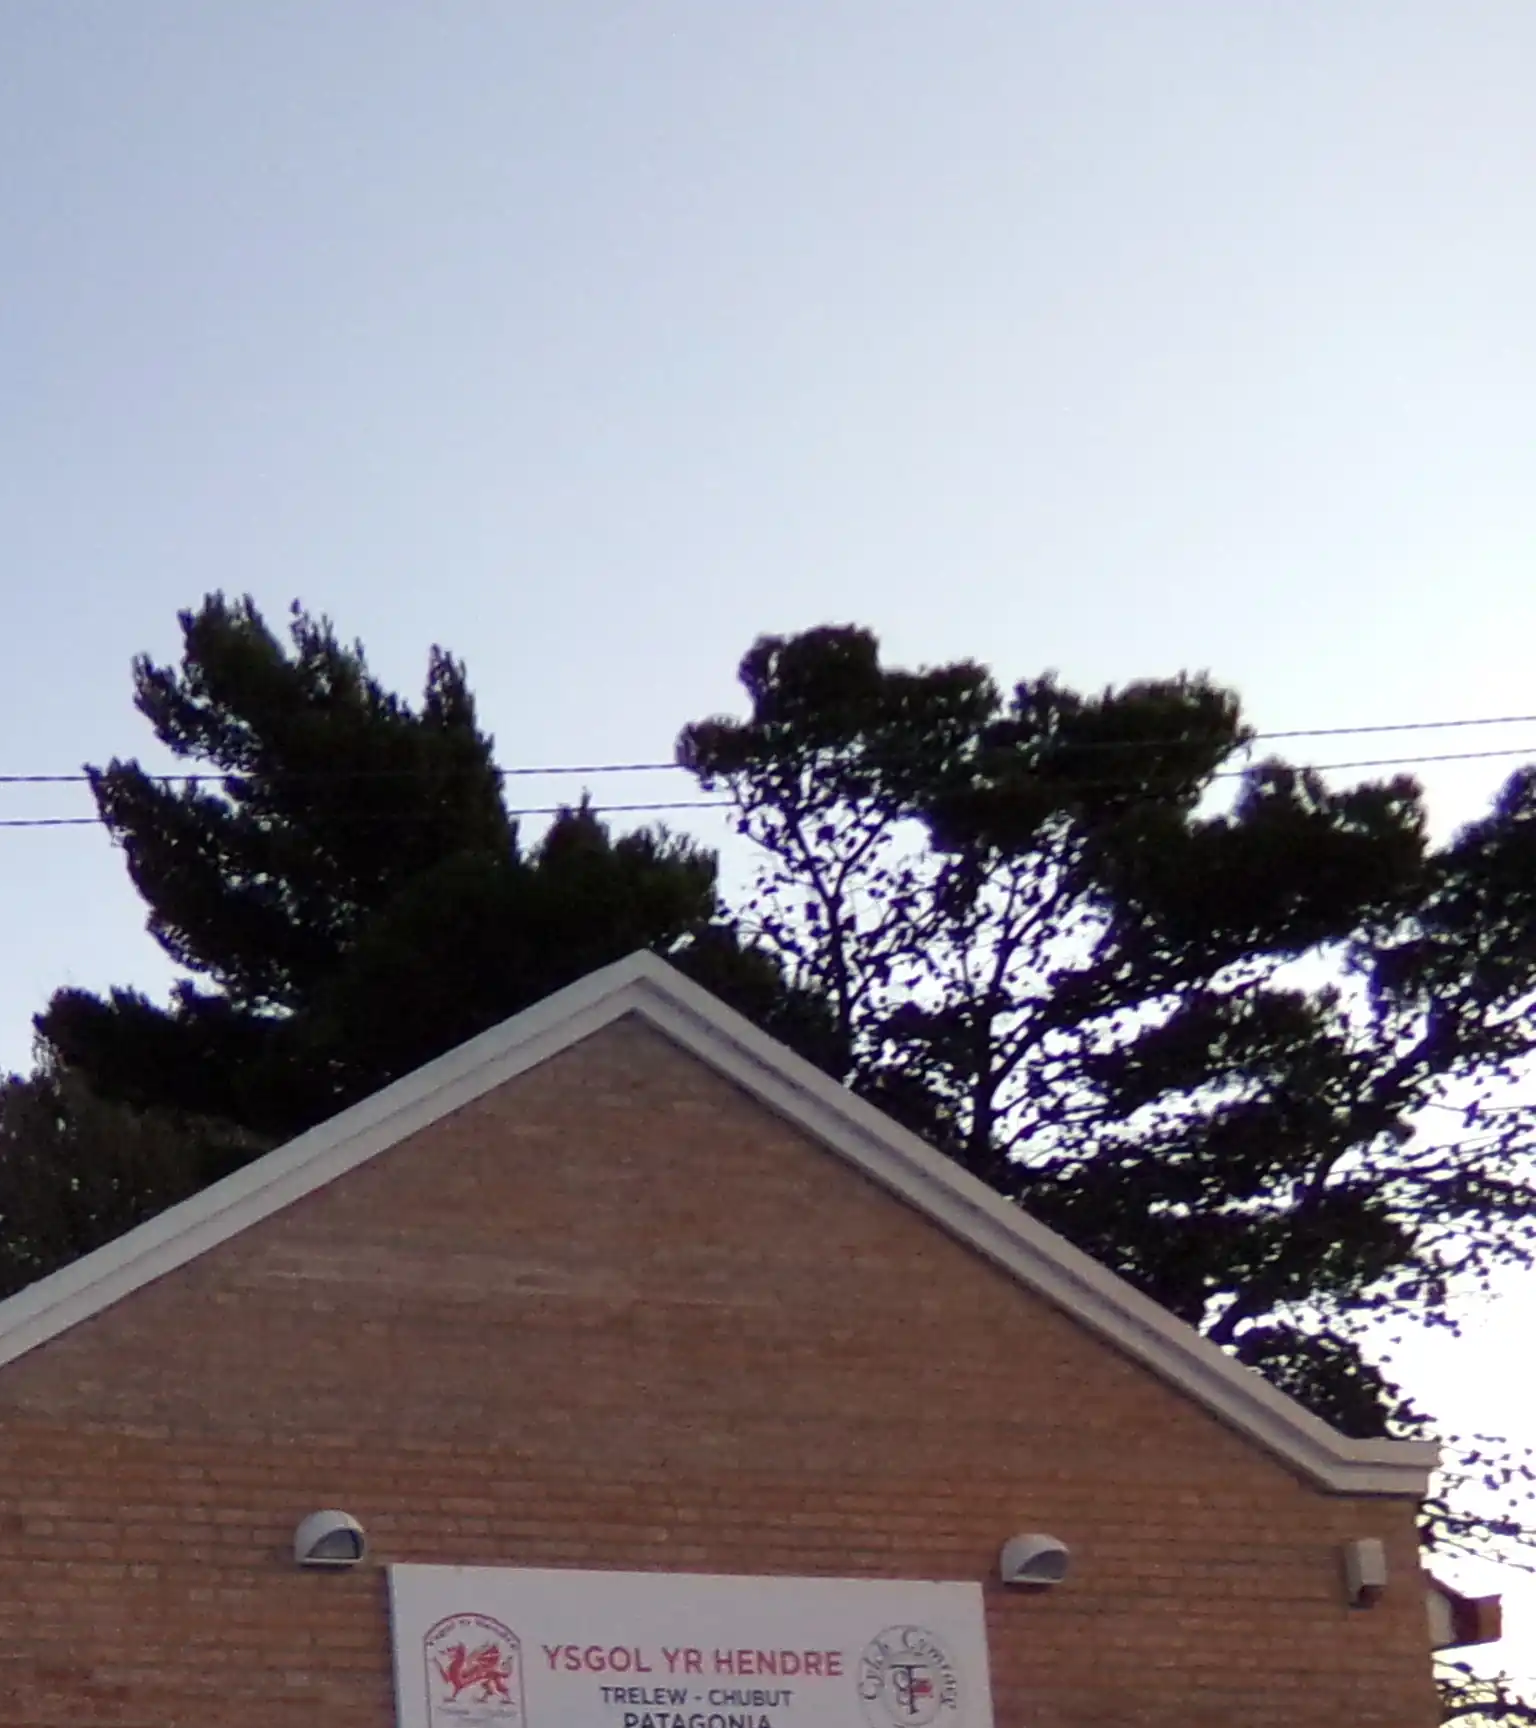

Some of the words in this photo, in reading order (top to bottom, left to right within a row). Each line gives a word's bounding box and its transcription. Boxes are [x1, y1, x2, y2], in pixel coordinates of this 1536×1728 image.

[541, 1645, 652, 1673] YSGOL
[662, 1648, 704, 1675] YR
[714, 1650, 844, 1677] HENDRE
[600, 1686, 688, 1706] TRELEW
[708, 1689, 794, 1708] CHUBUT
